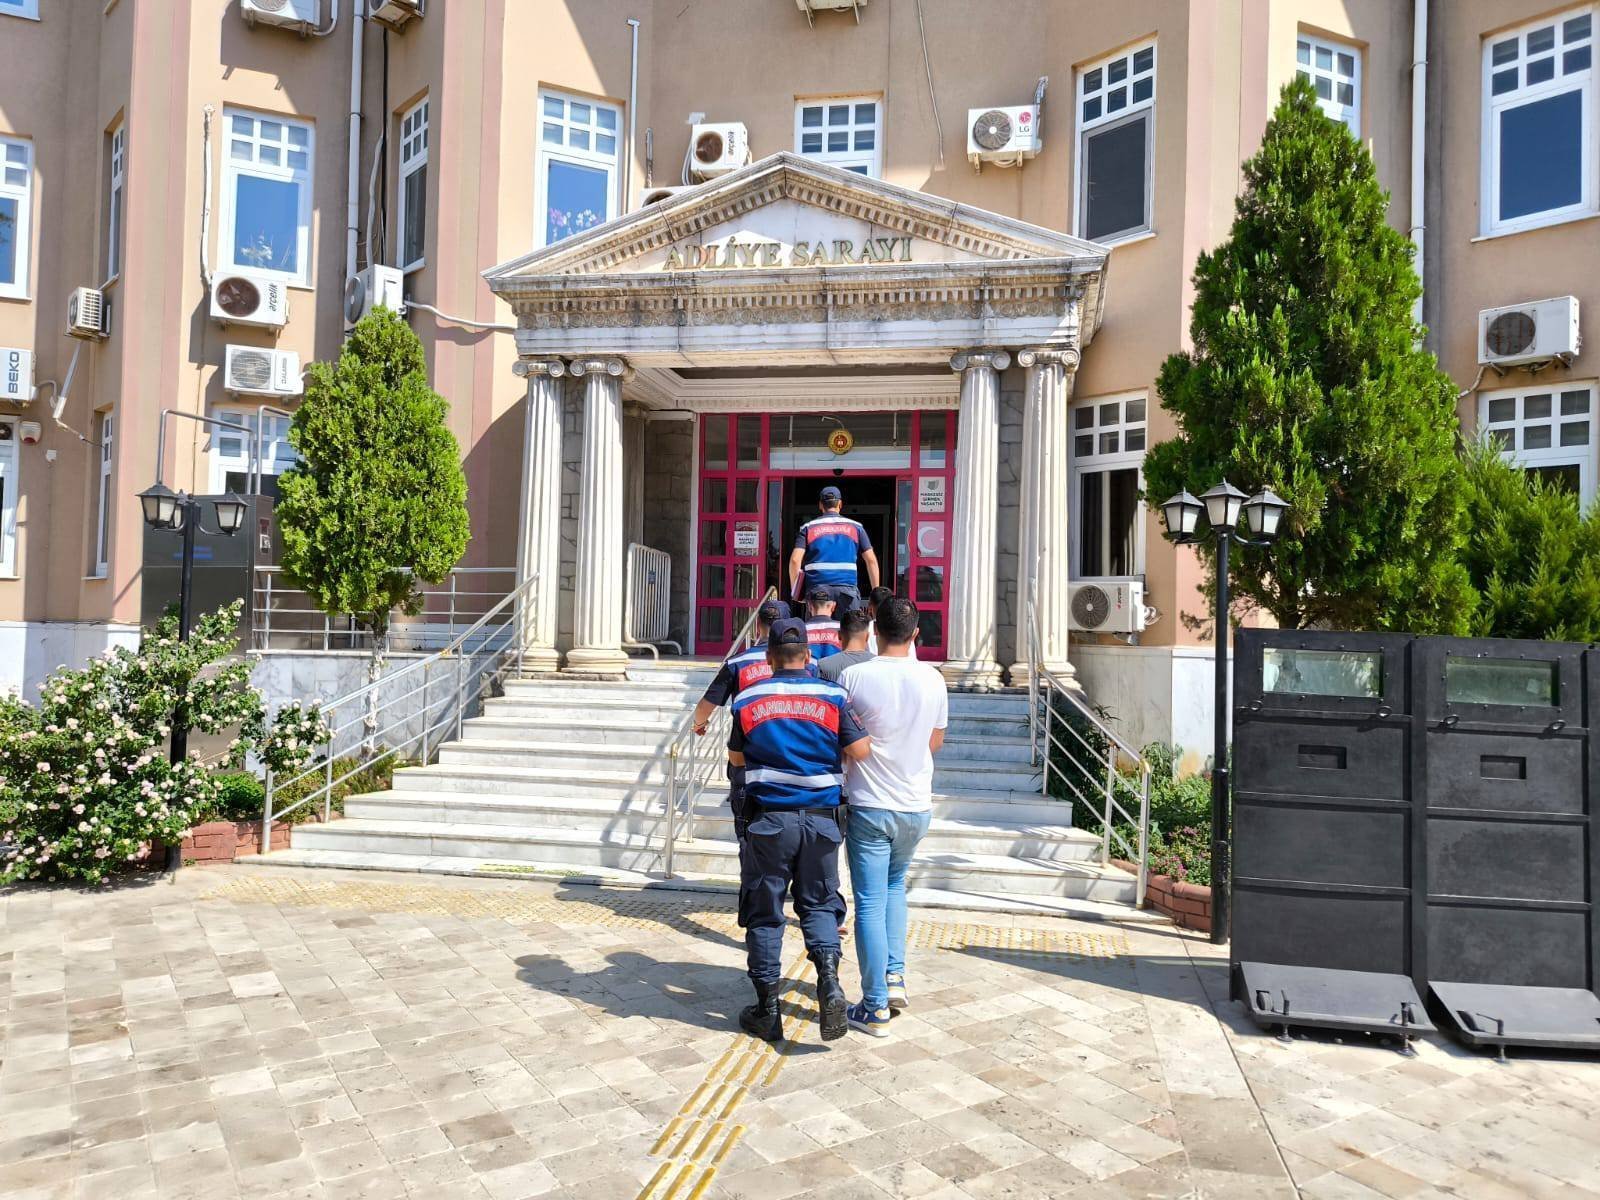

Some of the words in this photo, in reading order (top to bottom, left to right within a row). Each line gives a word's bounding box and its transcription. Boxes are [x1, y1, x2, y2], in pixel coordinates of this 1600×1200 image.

[1019, 125, 1030, 133] LG
[662, 236, 782, 271] ADLİYE
[790, 236, 913, 267] SARAYI
[8, 351, 20, 394] BEKO
[751, 700, 826, 722] JANDARMA
